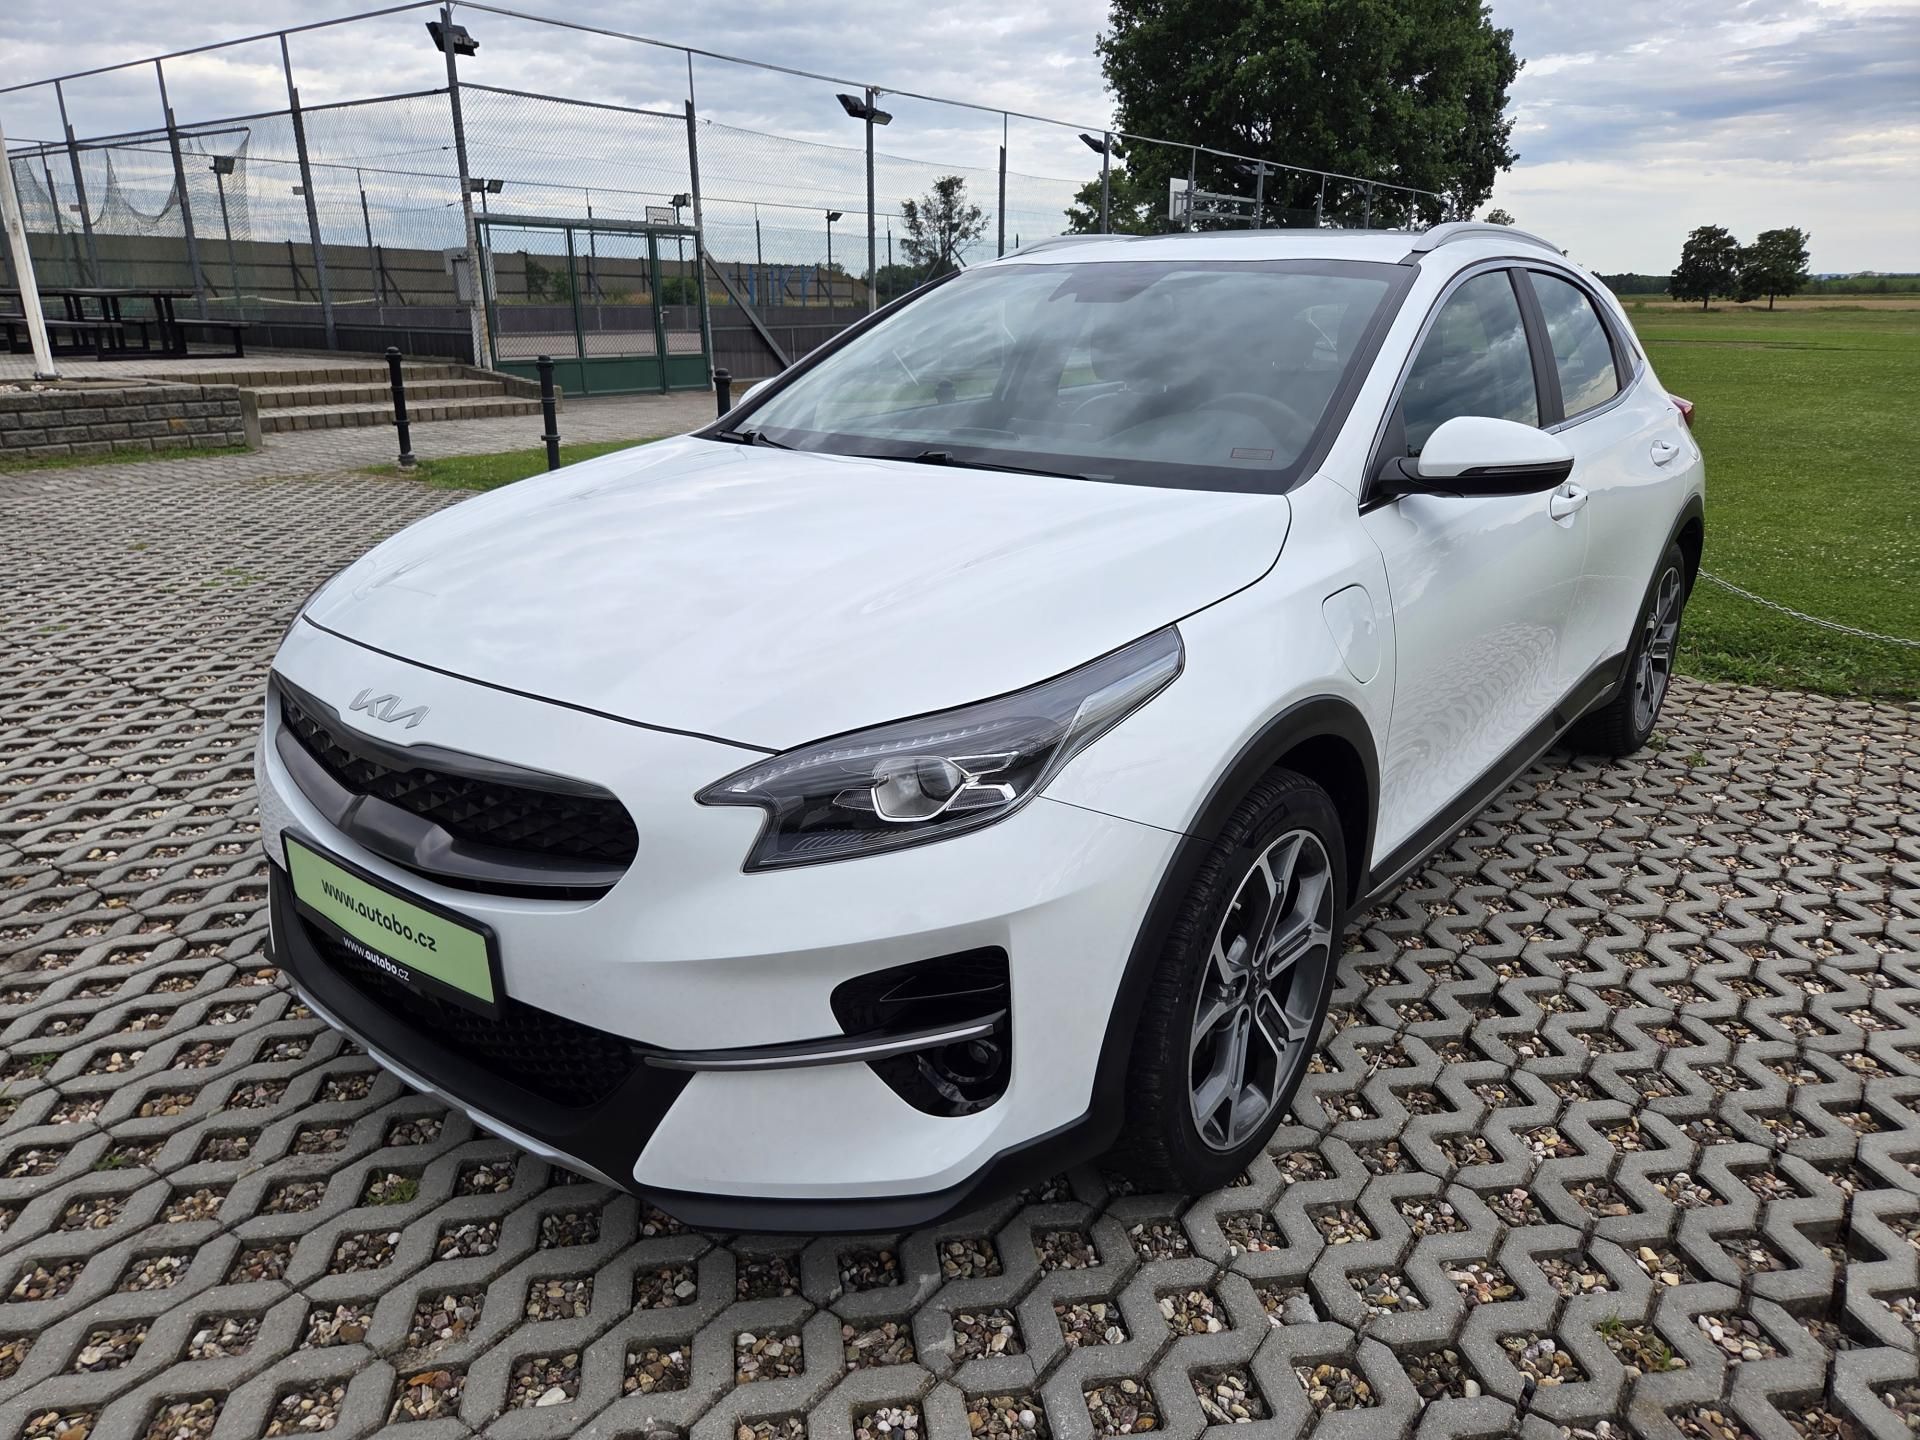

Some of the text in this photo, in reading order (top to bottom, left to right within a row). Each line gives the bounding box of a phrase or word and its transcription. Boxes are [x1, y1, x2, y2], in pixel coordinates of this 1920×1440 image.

[349, 687, 431, 730] KIA
[321, 878, 437, 953] www.autabo.cz
[343, 936, 410, 982] www.autabo.cz
